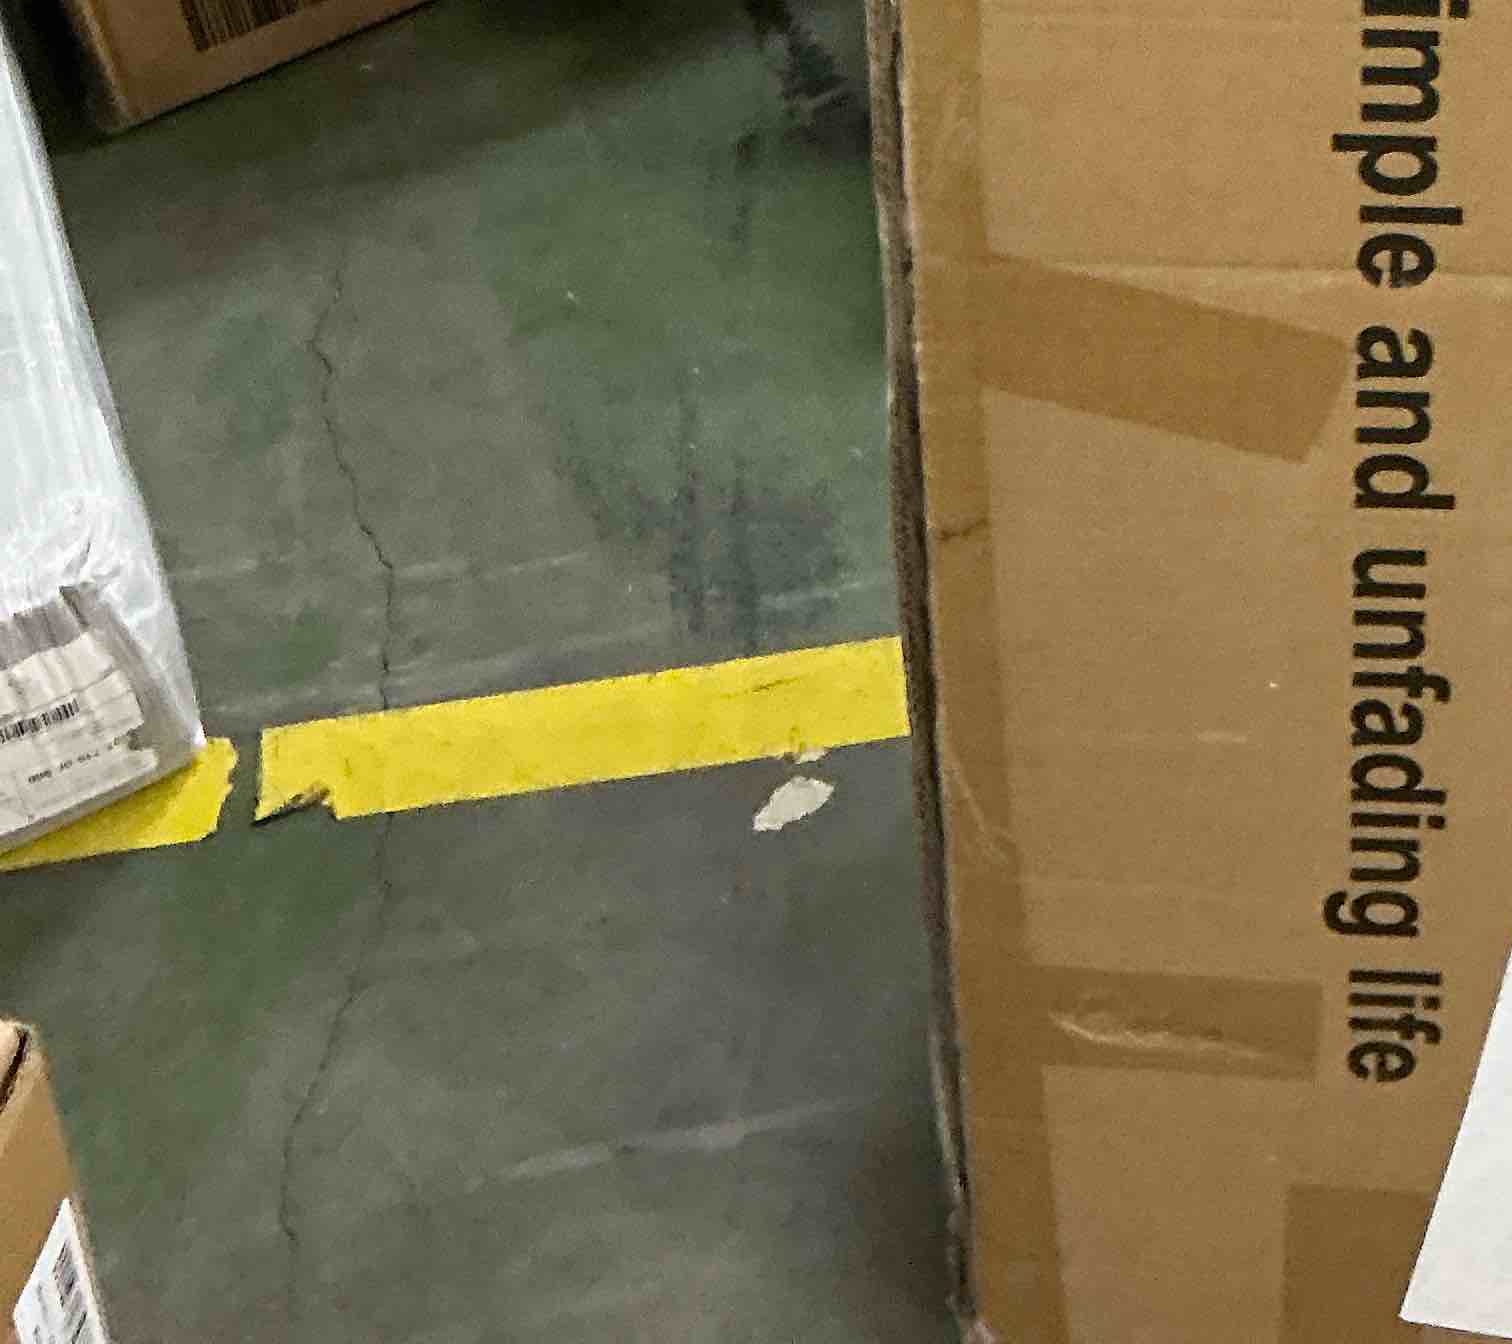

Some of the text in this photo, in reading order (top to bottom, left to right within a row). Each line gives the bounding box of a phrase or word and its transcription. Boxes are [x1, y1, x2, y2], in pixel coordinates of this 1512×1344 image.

[1354, 326, 1458, 512] and
[1324, 550, 1453, 940] unfading
[1346, 967, 1444, 1087] life
